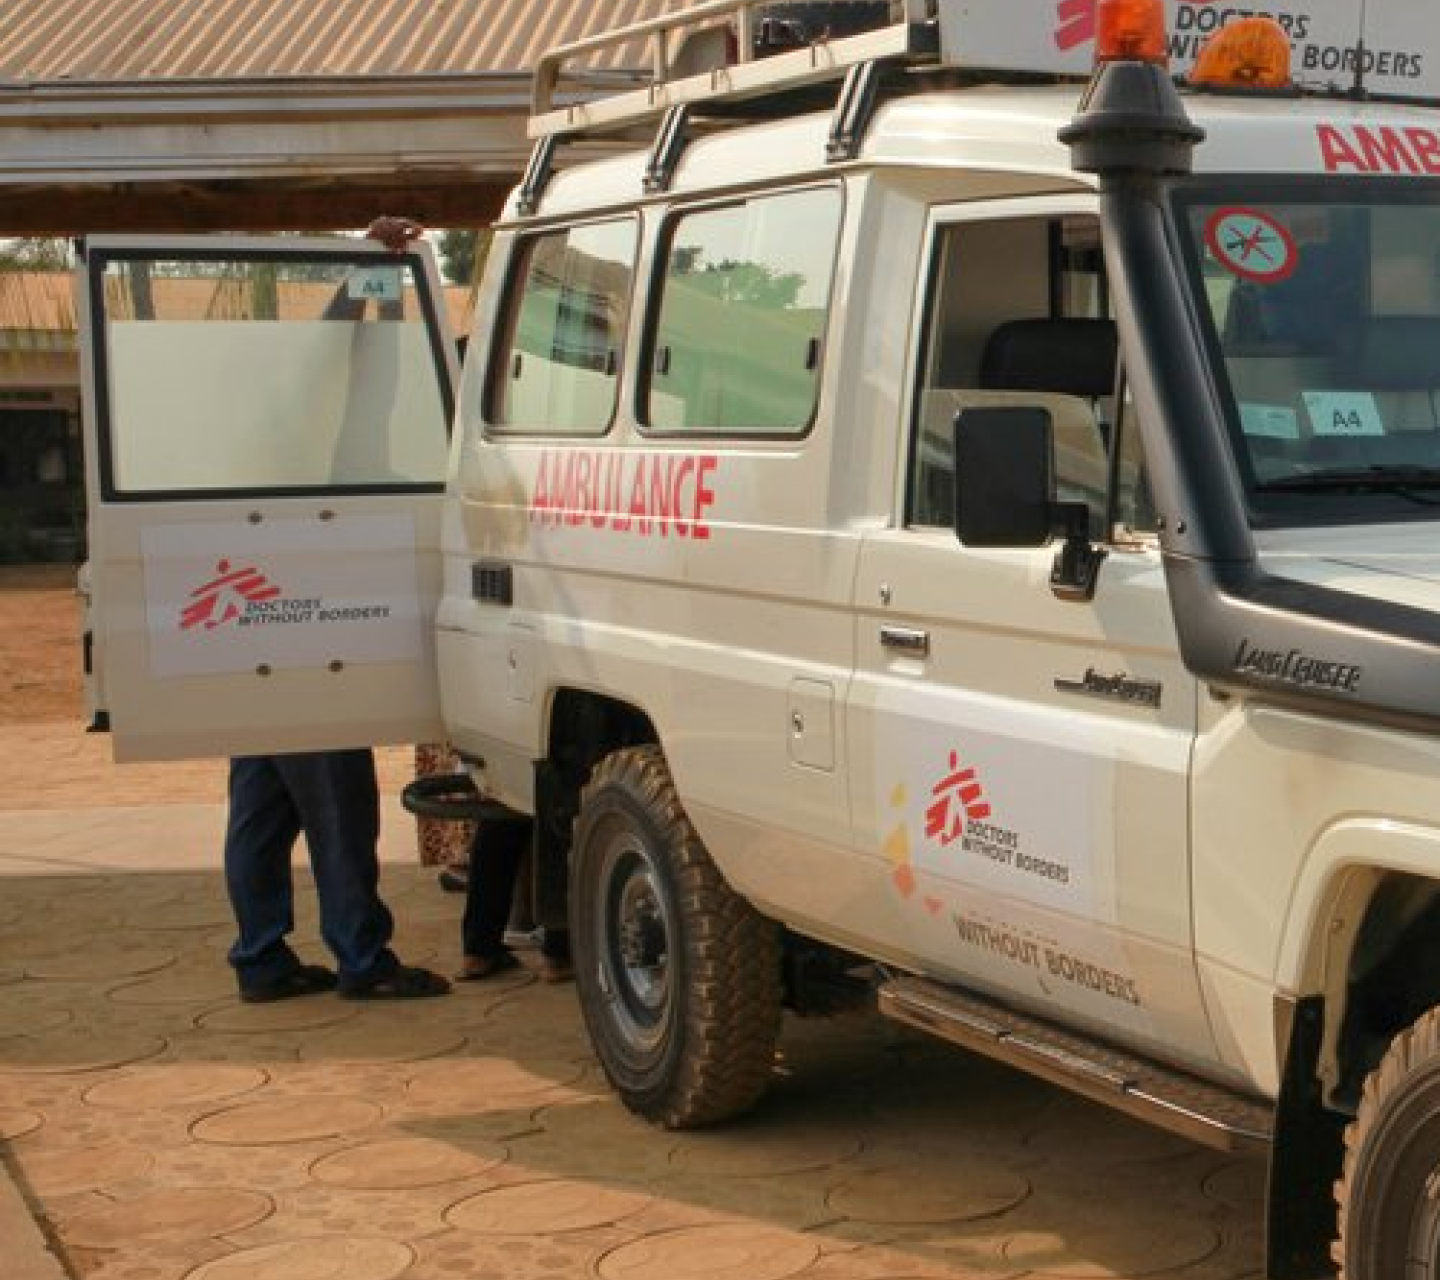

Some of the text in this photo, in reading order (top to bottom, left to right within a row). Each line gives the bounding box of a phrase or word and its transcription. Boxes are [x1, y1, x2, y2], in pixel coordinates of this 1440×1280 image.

[1302, 45, 1423, 78] BORDERS
[528, 450, 718, 540] AMBULANCE
[239, 605, 389, 625] WITHOUT BORDERS
[246, 599, 321, 612] DOCTORS
[966, 819, 1018, 848] DOCTORS
[962, 836, 1069, 882] WITHOUT BORDERS
[1045, 948, 1140, 1005] BORDERS
